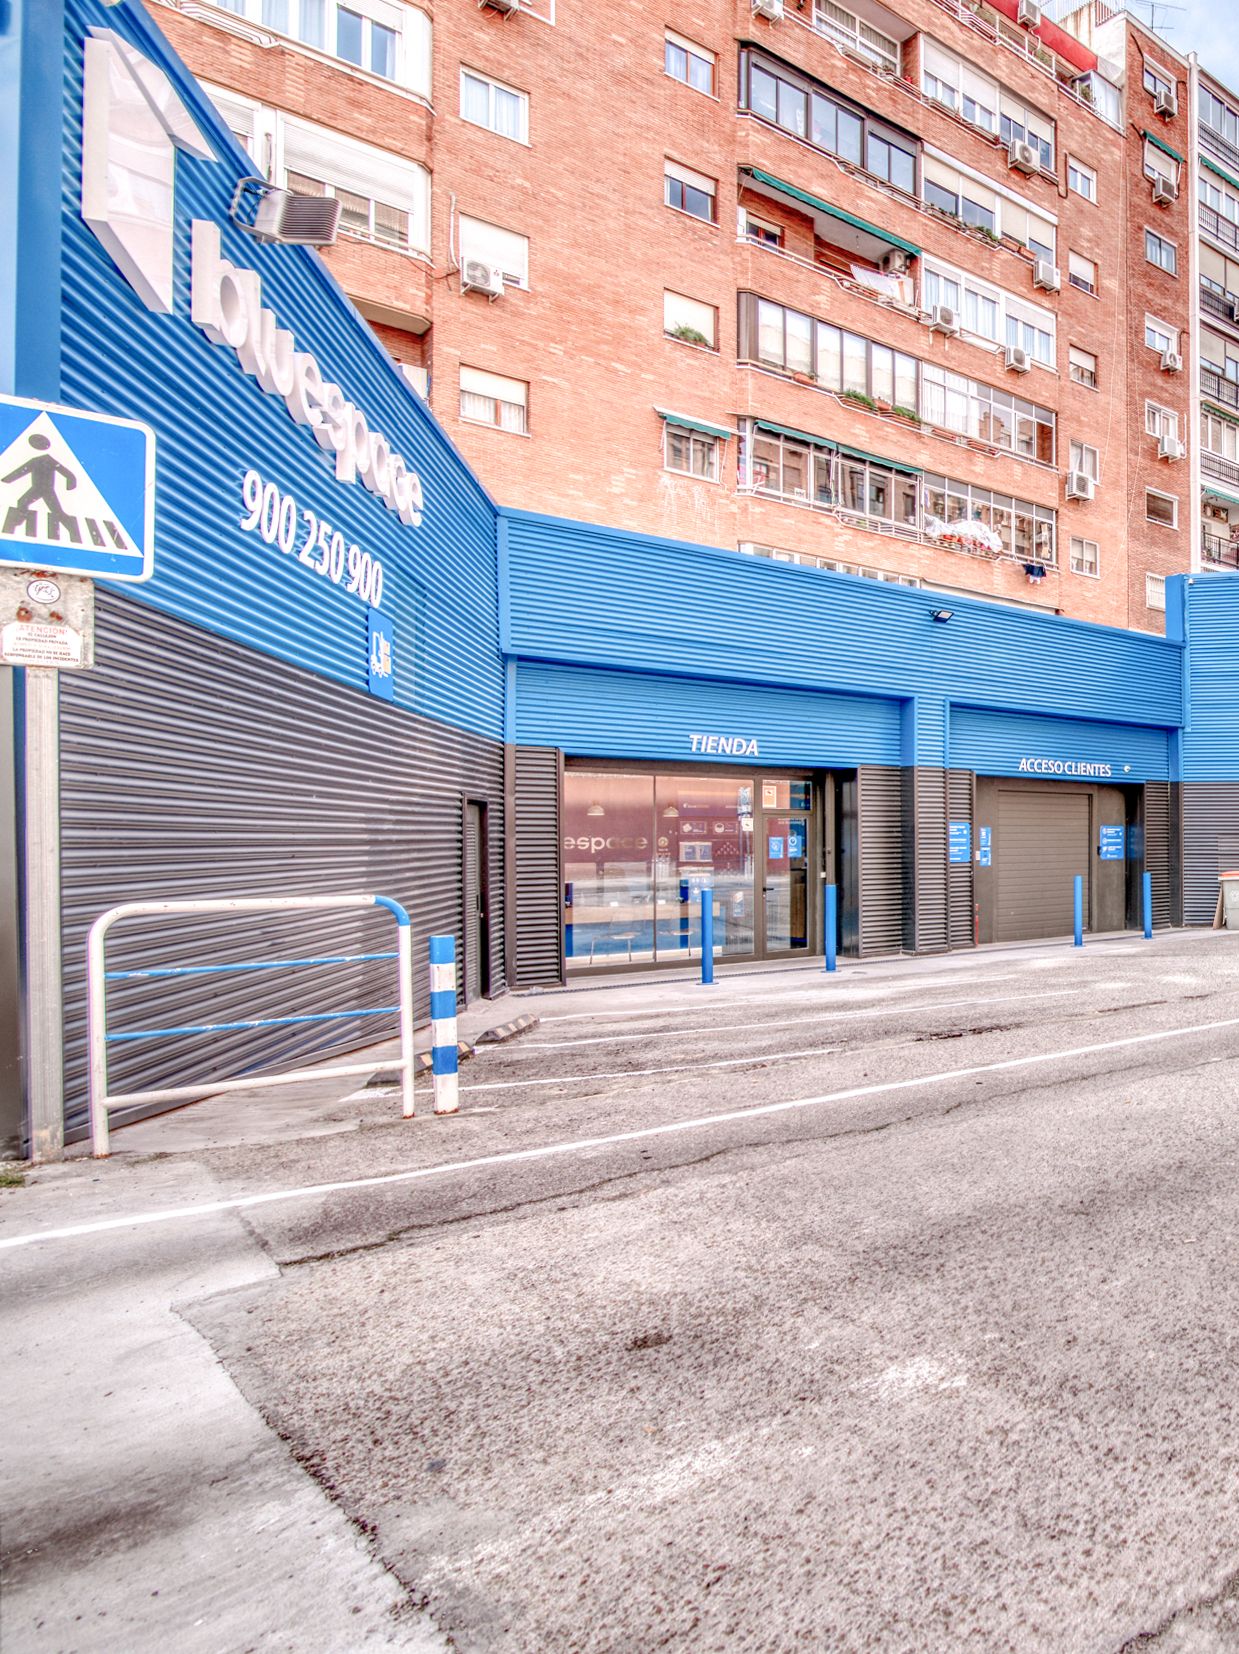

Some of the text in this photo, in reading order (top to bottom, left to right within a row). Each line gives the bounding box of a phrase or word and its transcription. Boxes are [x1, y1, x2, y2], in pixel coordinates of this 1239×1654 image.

[192, 219, 423, 527] bluespace
[240, 470, 383, 608] 900 250 900
[689, 734, 759, 757] TIENDA
[1019, 758, 1112, 777] ACCESO CLIENTES
